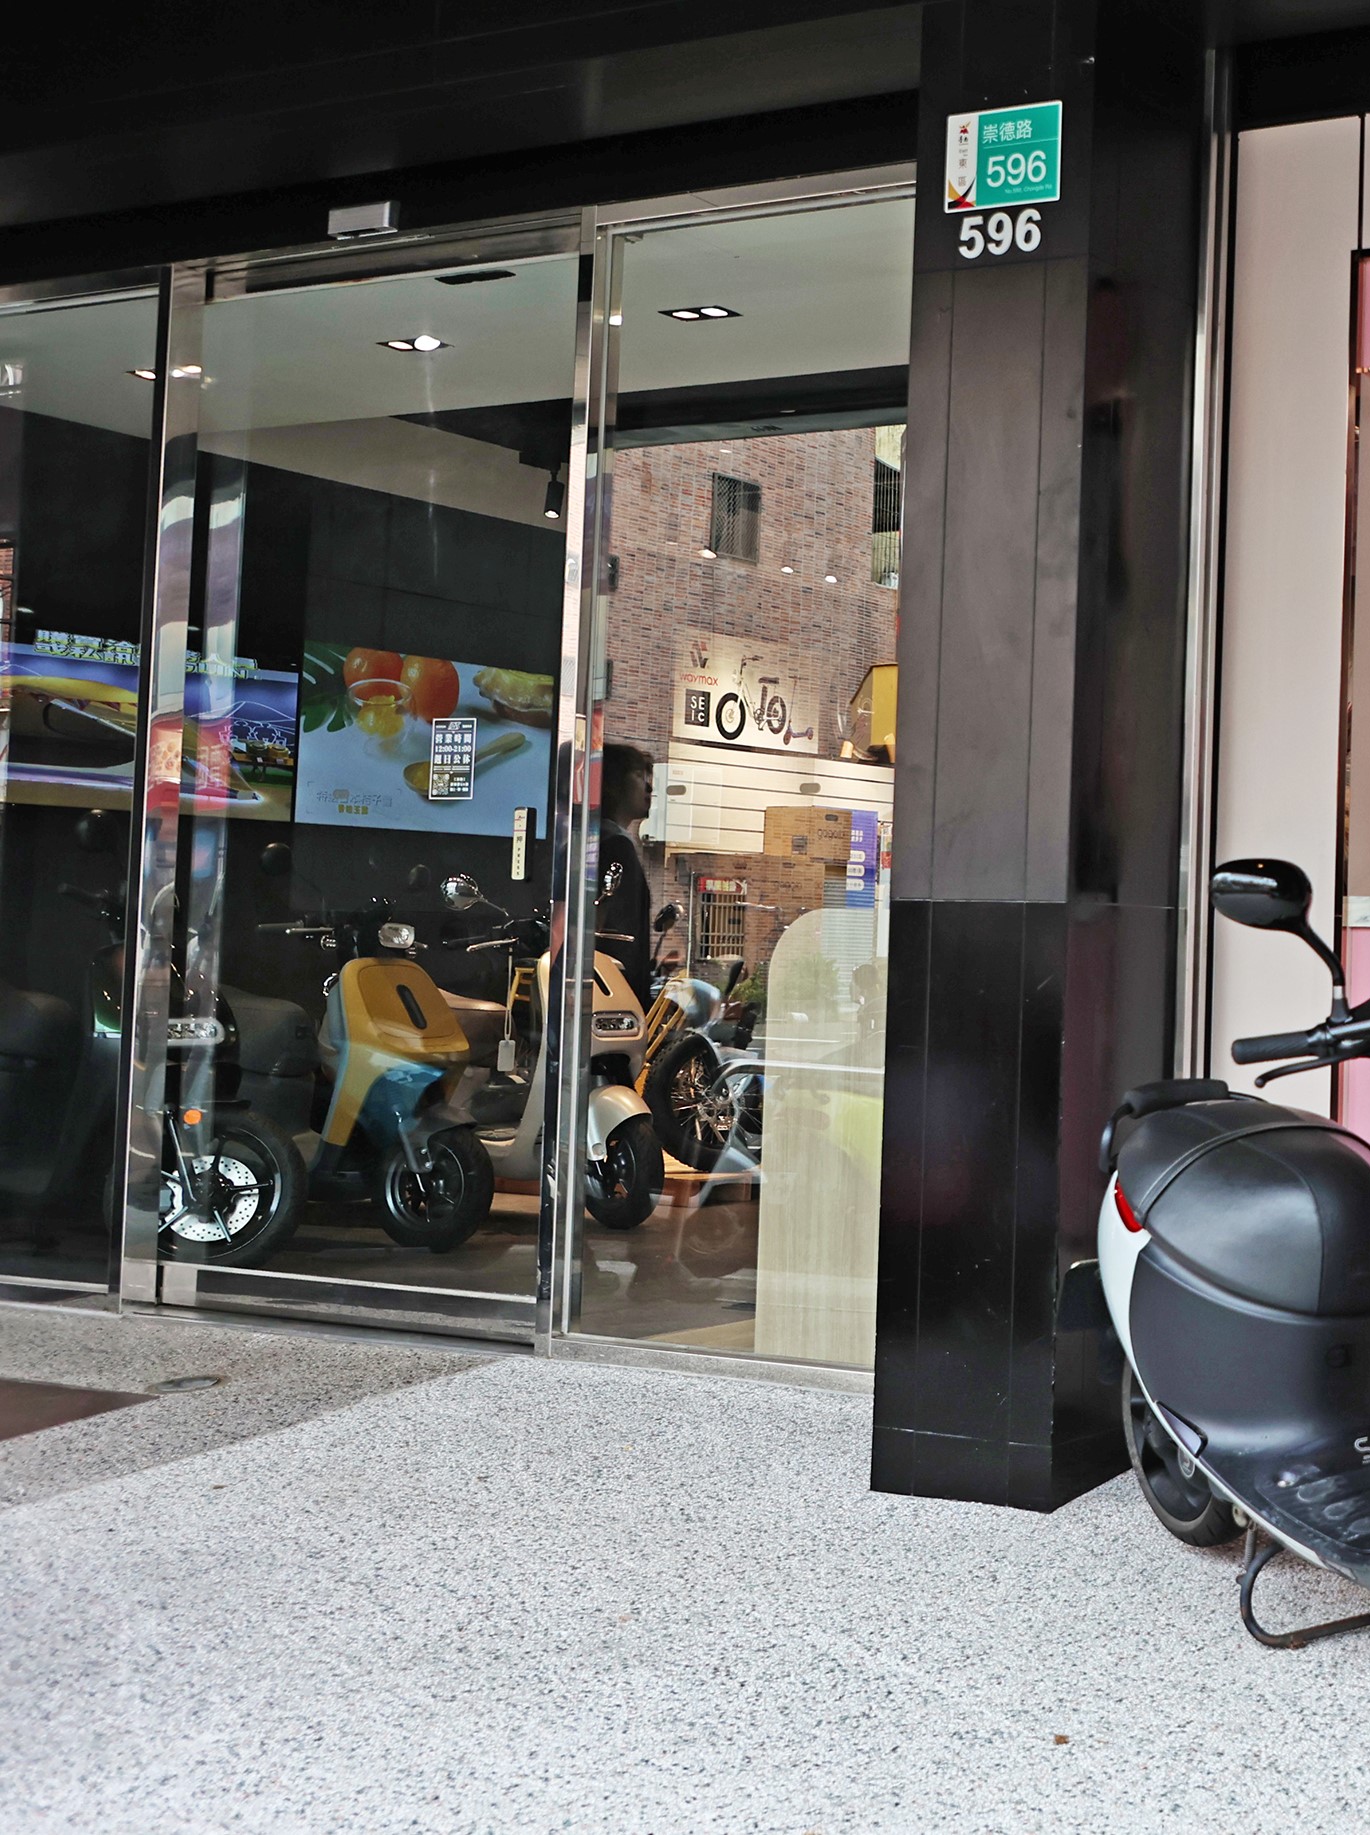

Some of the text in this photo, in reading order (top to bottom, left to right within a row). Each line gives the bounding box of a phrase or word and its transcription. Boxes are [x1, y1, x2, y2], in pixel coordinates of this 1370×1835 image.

[982, 119, 1033, 144] 崇德路
[986, 150, 1047, 188] 596
[957, 207, 1042, 259] 596
[681, 673, 718, 686] waymax
[435, 733, 472, 744] 營業時間
